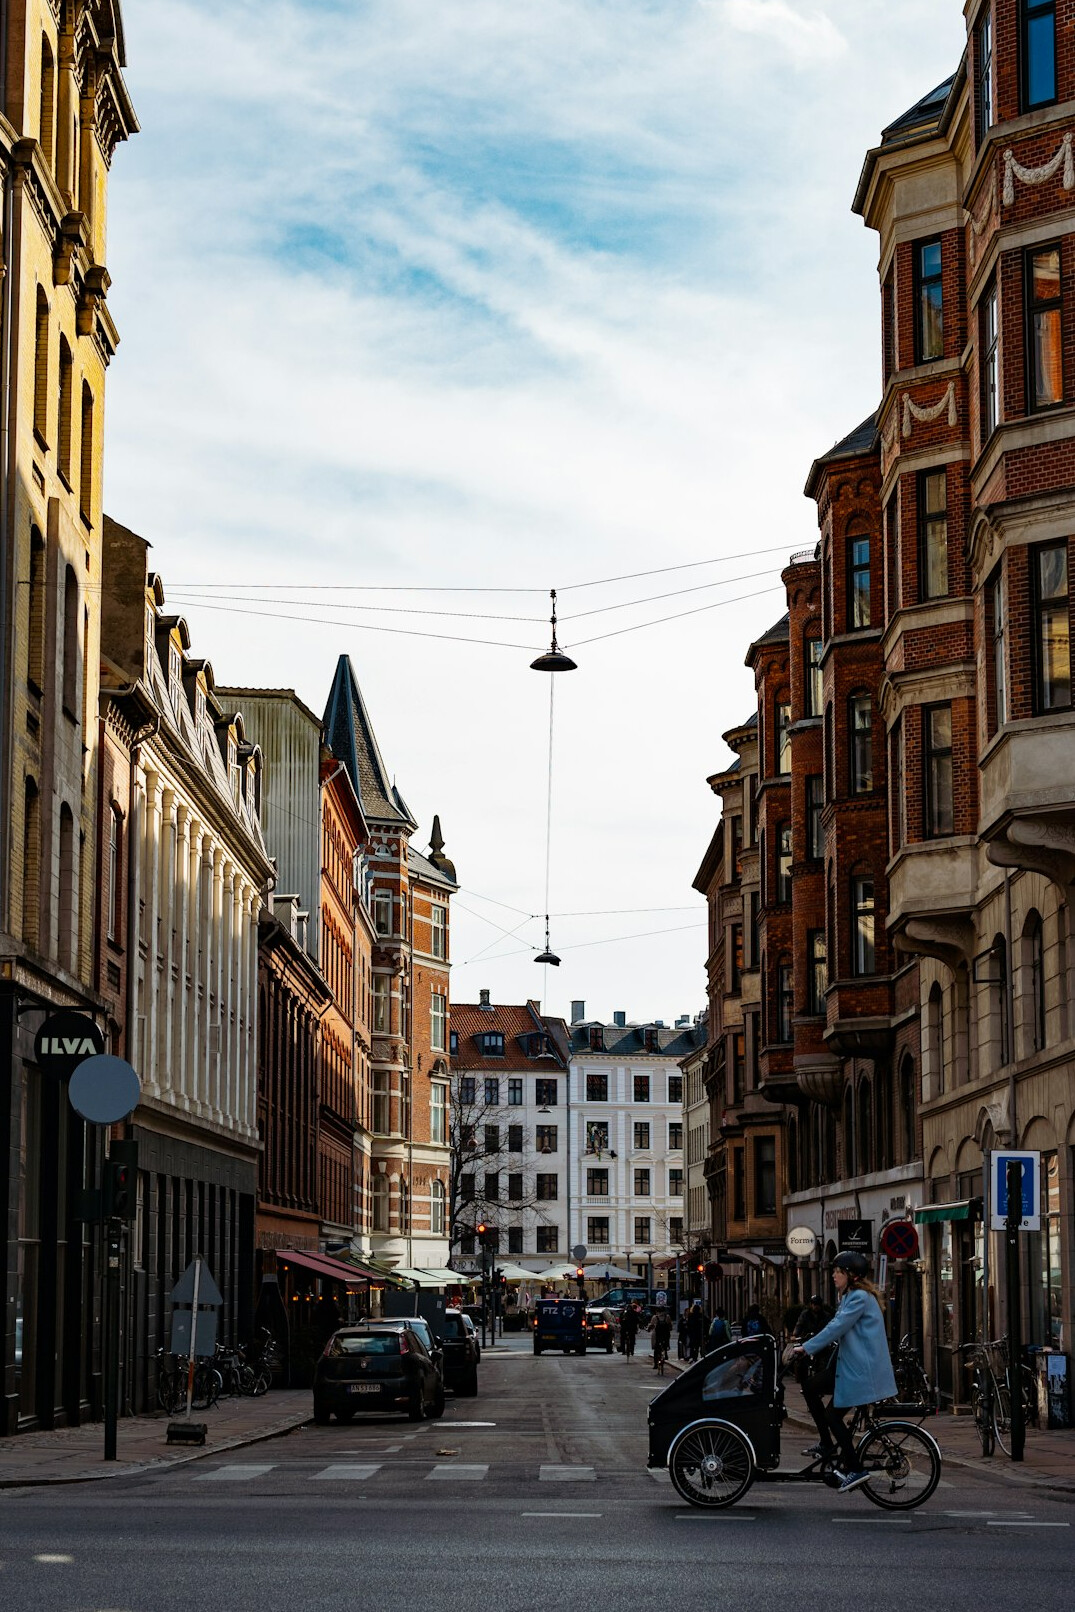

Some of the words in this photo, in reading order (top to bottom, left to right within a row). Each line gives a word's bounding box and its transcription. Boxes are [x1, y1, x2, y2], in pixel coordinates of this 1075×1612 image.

[41, 1037, 97, 1055] ILVA
[1002, 1218, 1029, 1226] Ze
[542, 1307, 559, 1315] FTZ
